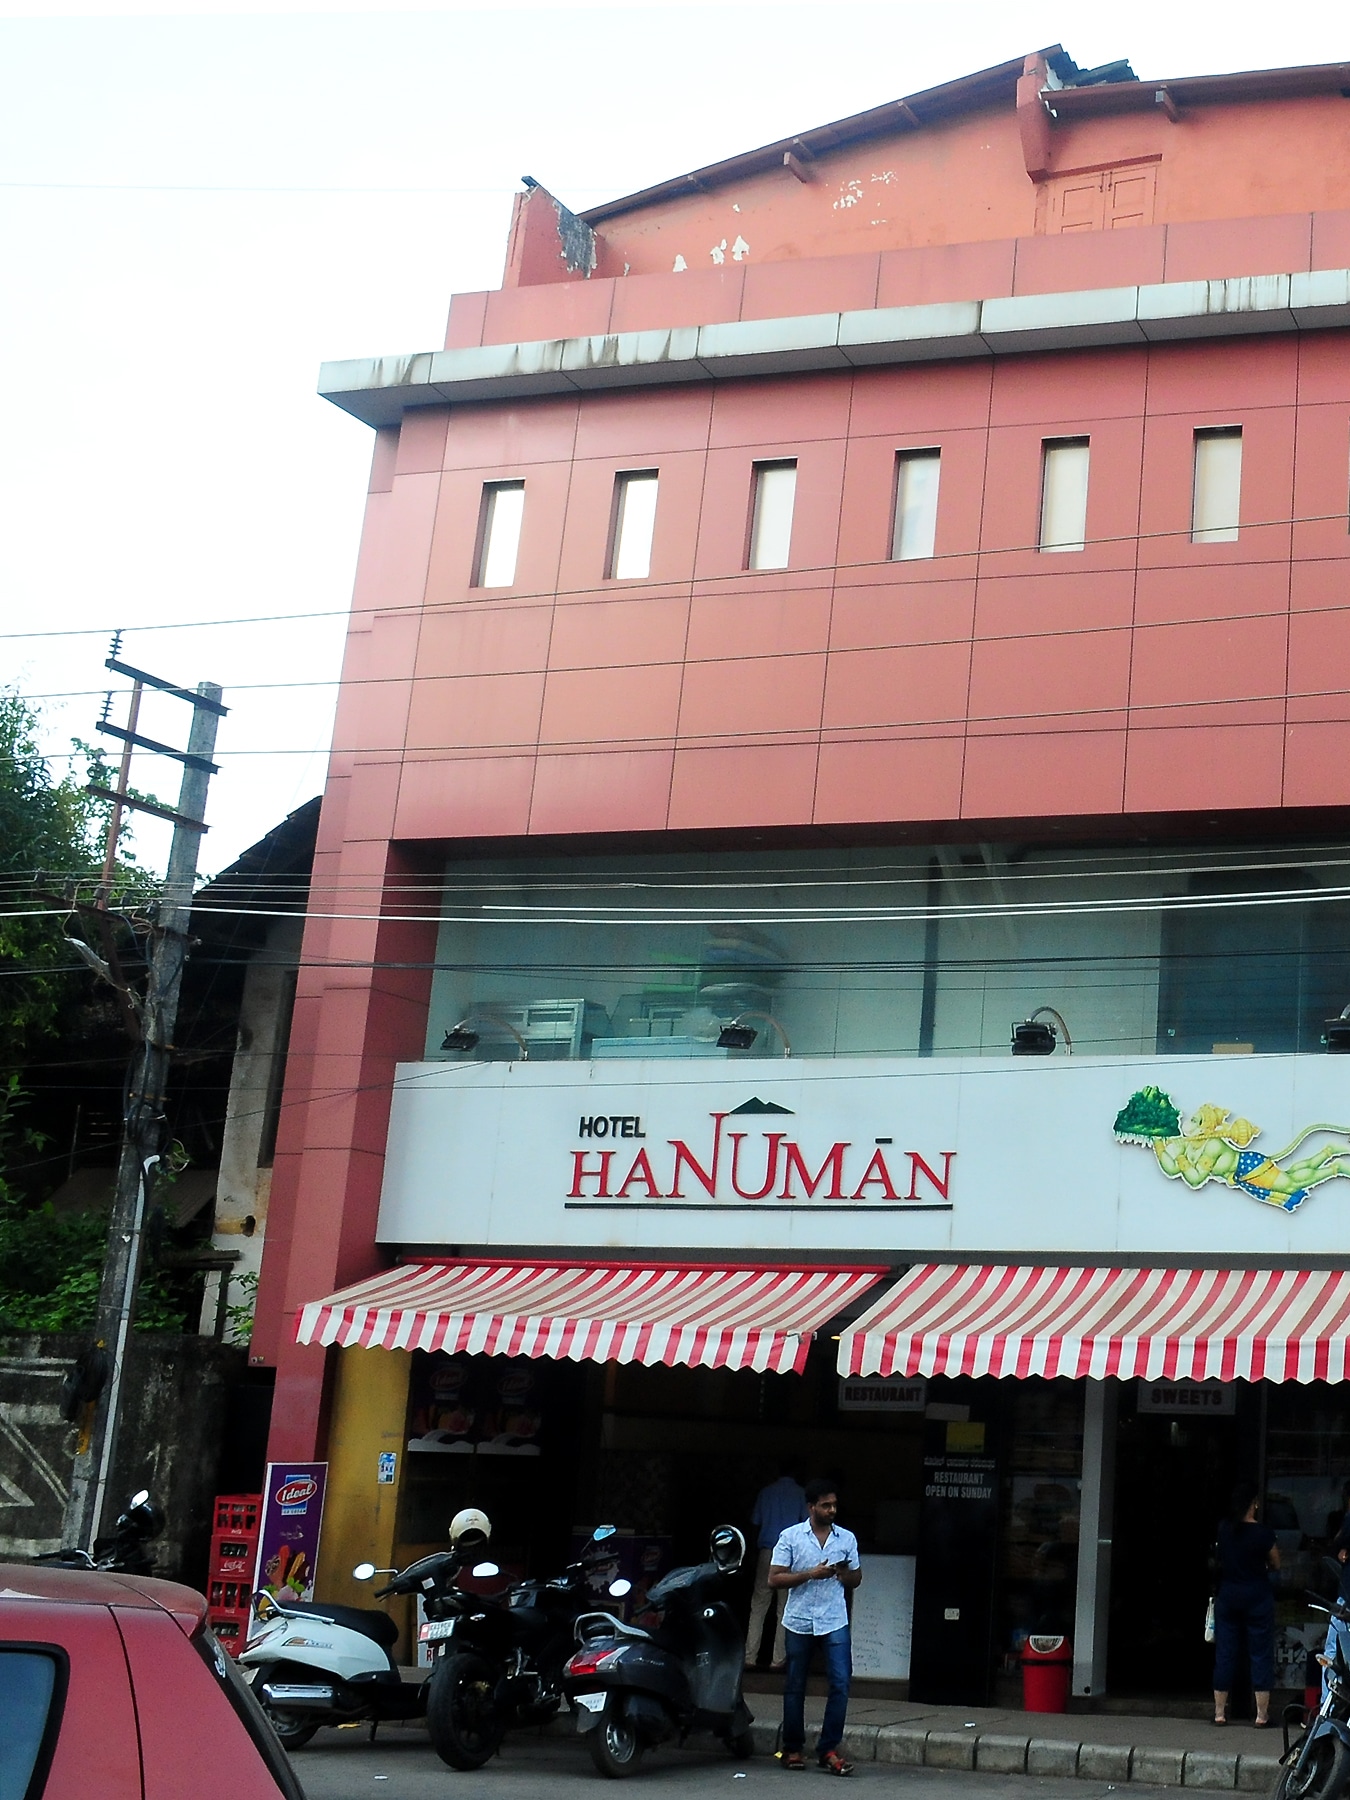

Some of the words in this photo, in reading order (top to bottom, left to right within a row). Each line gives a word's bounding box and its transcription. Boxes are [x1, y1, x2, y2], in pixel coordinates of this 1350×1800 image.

[579, 1116, 646, 1138] HOTEL
[845, 1387, 922, 1402] RESTAURANT
[1151, 1388, 1223, 1405] SWEETS
[934, 1471, 985, 1485] RESTAURANT
[281, 1482, 313, 1502] Ideal
[925, 1484, 947, 1498] OPEN
[947, 1485, 960, 1498] ON
[960, 1486, 993, 1499] SUNDAY
